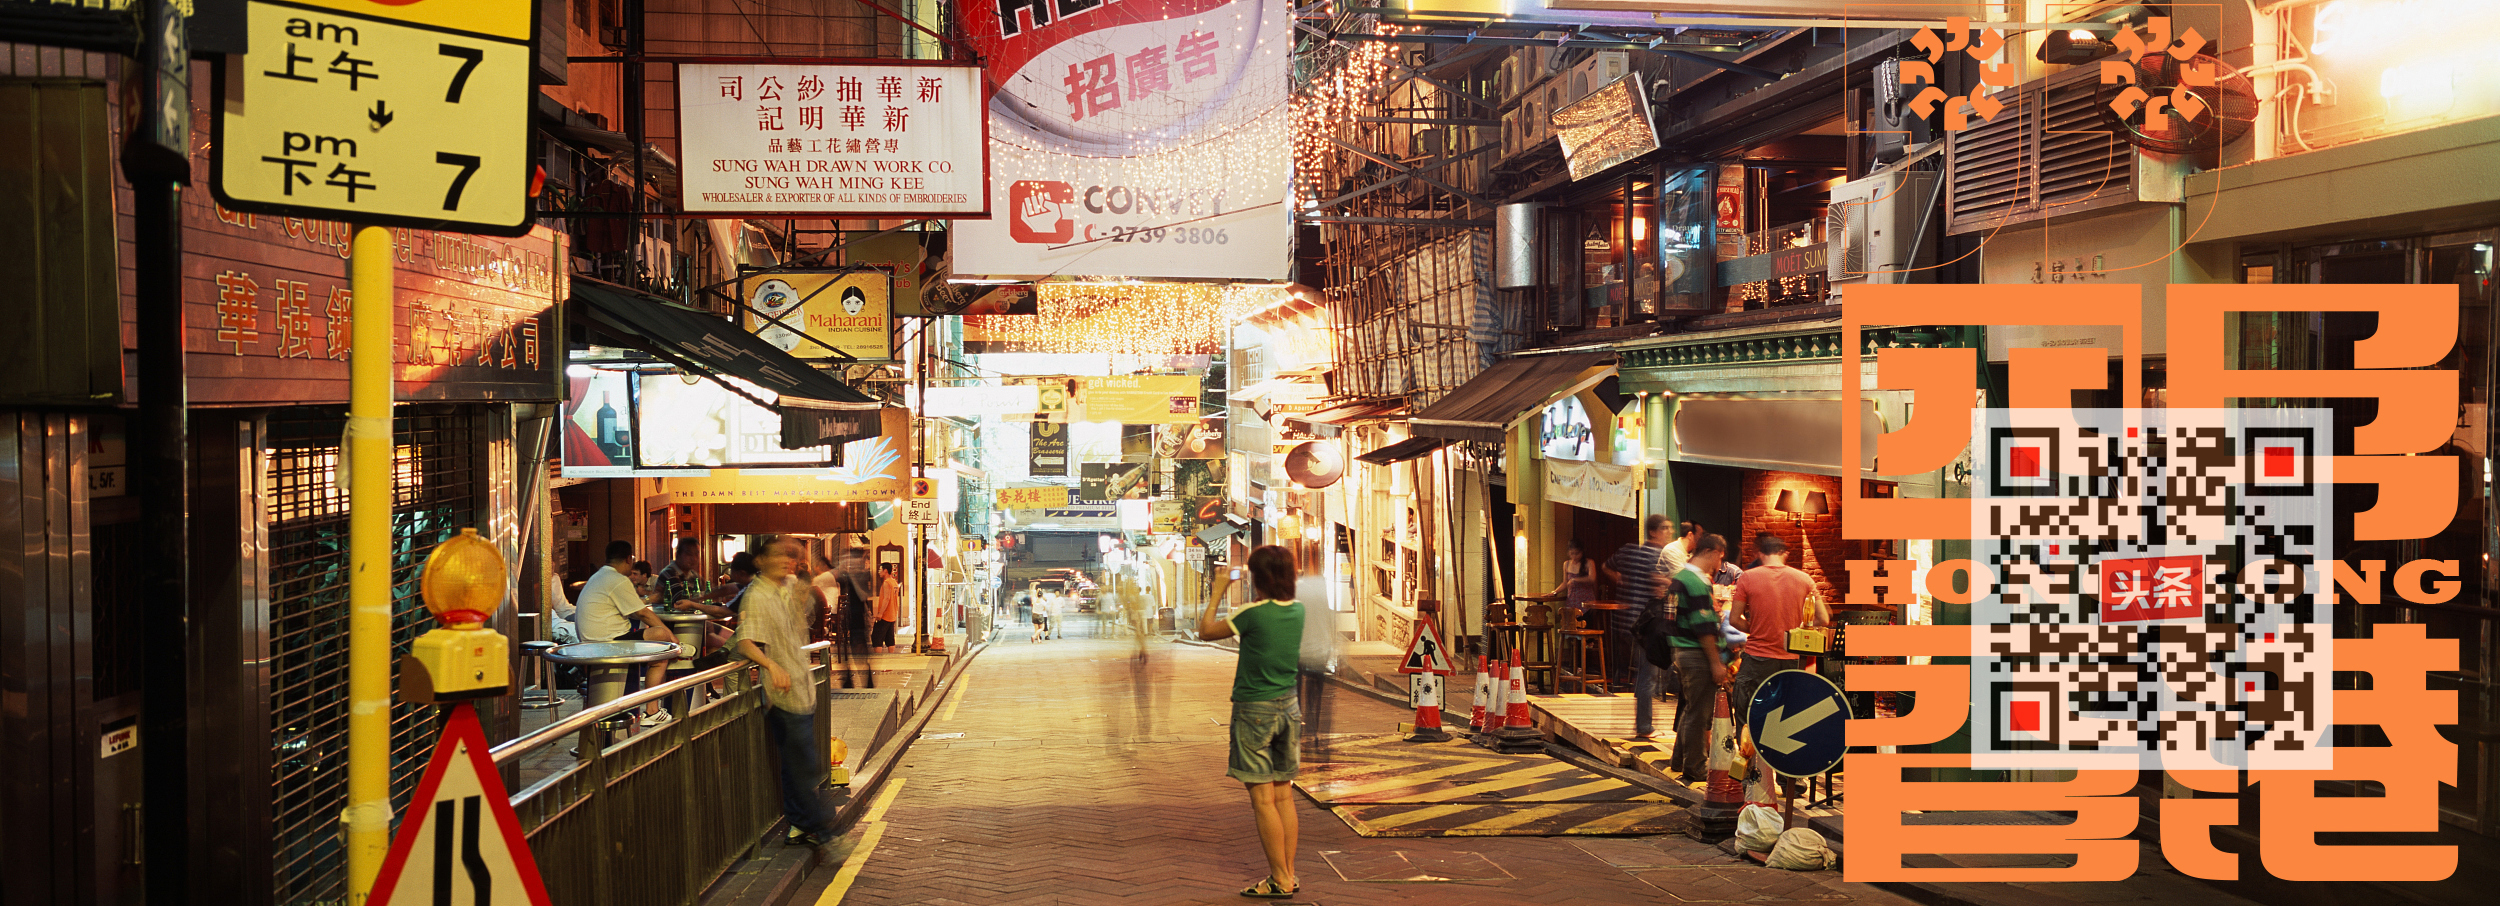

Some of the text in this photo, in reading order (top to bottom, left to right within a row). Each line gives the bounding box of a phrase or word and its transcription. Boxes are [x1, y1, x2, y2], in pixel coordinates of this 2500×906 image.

[285, 18, 359, 46] am
[264, 42, 378, 91] 上午
[439, 43, 483, 104] 7
[1064, 30, 1219, 122] 招廣告
[283, 131, 357, 158] pm
[712, 160, 955, 173] SUNG WAH DRAWN WORK CO.
[262, 156, 376, 203] 下午
[436, 152, 480, 212] 7
[745, 177, 925, 190] SUNG WAH MING KEE
[702, 193, 967, 204] WHOLESALER & EXPORTER OF ALL KINDS OF EMBROIDERIES
[1084, 185, 1226, 215] CONVEY
[1112, 226, 1229, 245] 2739 3806
[1805, 248, 1828, 270] SUM
[997, 287, 1028, 299] Carlsberg
[810, 313, 882, 327] Maharani
[1088, 377, 1141, 389] get wicked.
[1033, 438, 1047, 446] The
[1194, 428, 1222, 440] Carlsberg
[774, 489, 840, 497] MARGARITA
[908, 510, 932, 520] 終止
